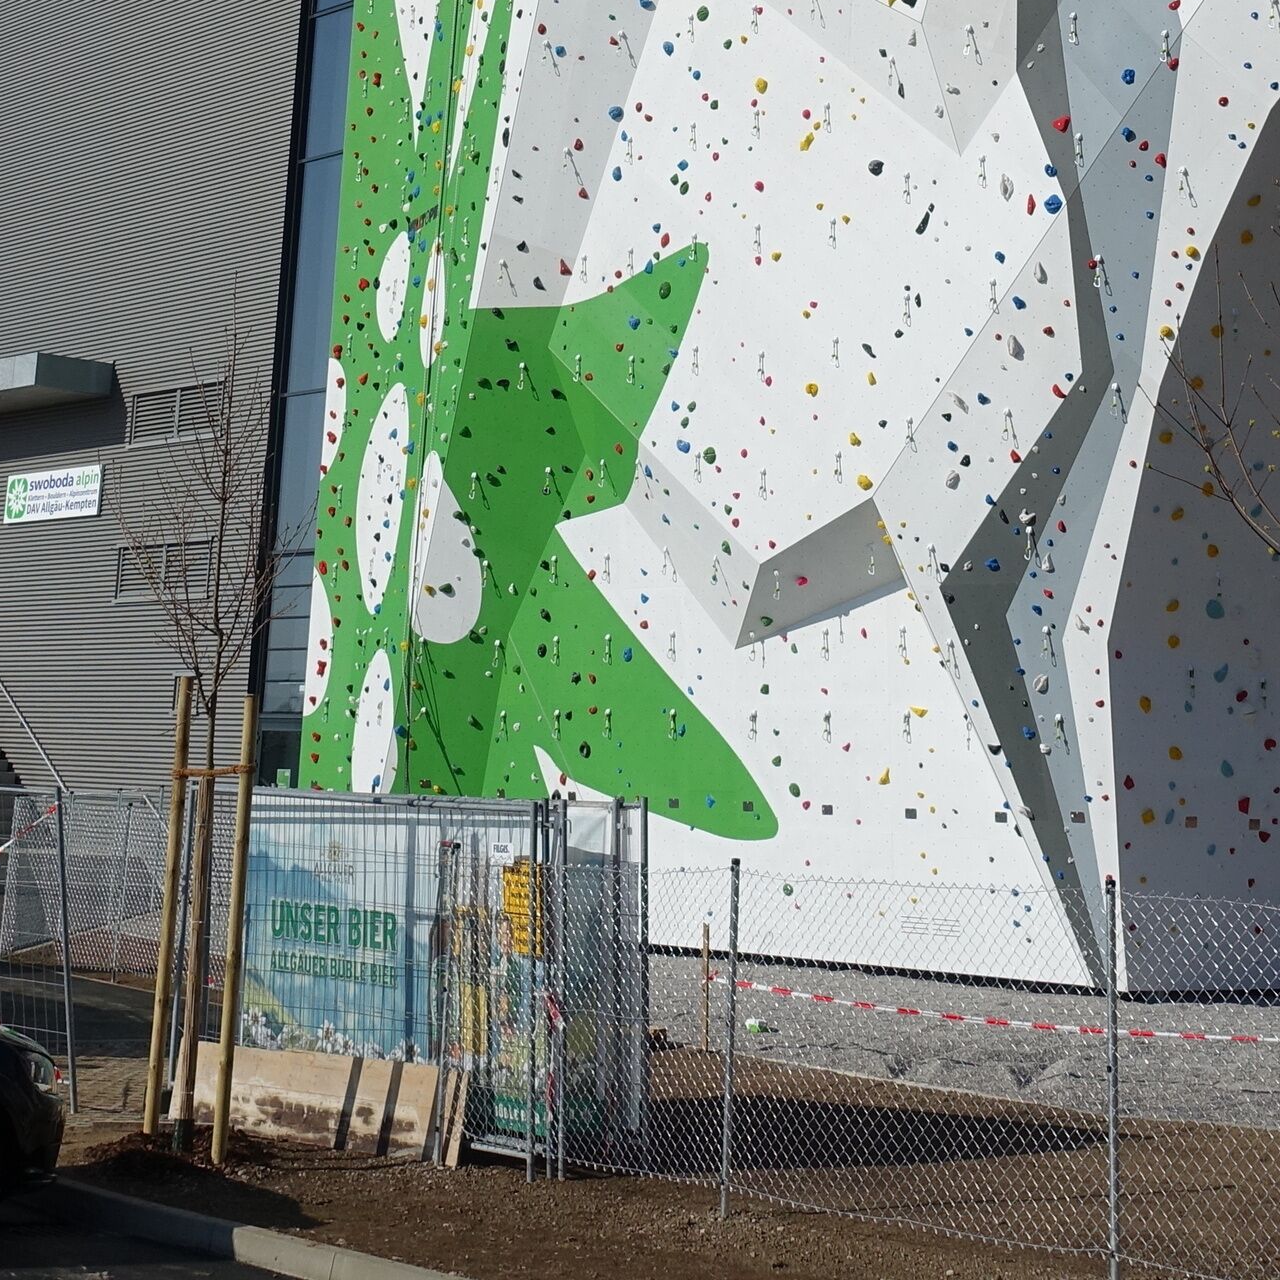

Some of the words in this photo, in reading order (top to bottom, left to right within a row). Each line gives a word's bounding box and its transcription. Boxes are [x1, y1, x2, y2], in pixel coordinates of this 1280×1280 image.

[29, 472, 75, 491] swoboda
[76, 469, 99, 488] alpin
[26, 502, 40, 514] DAV
[41, 499, 97, 515] Allgäu-Kempten
[271, 899, 341, 944] UNSER
[348, 907, 397, 951] BIER
[270, 949, 327, 976] ALLGÄUER
[330, 954, 367, 981] BÜBLE
[370, 963, 396, 986] BIER
